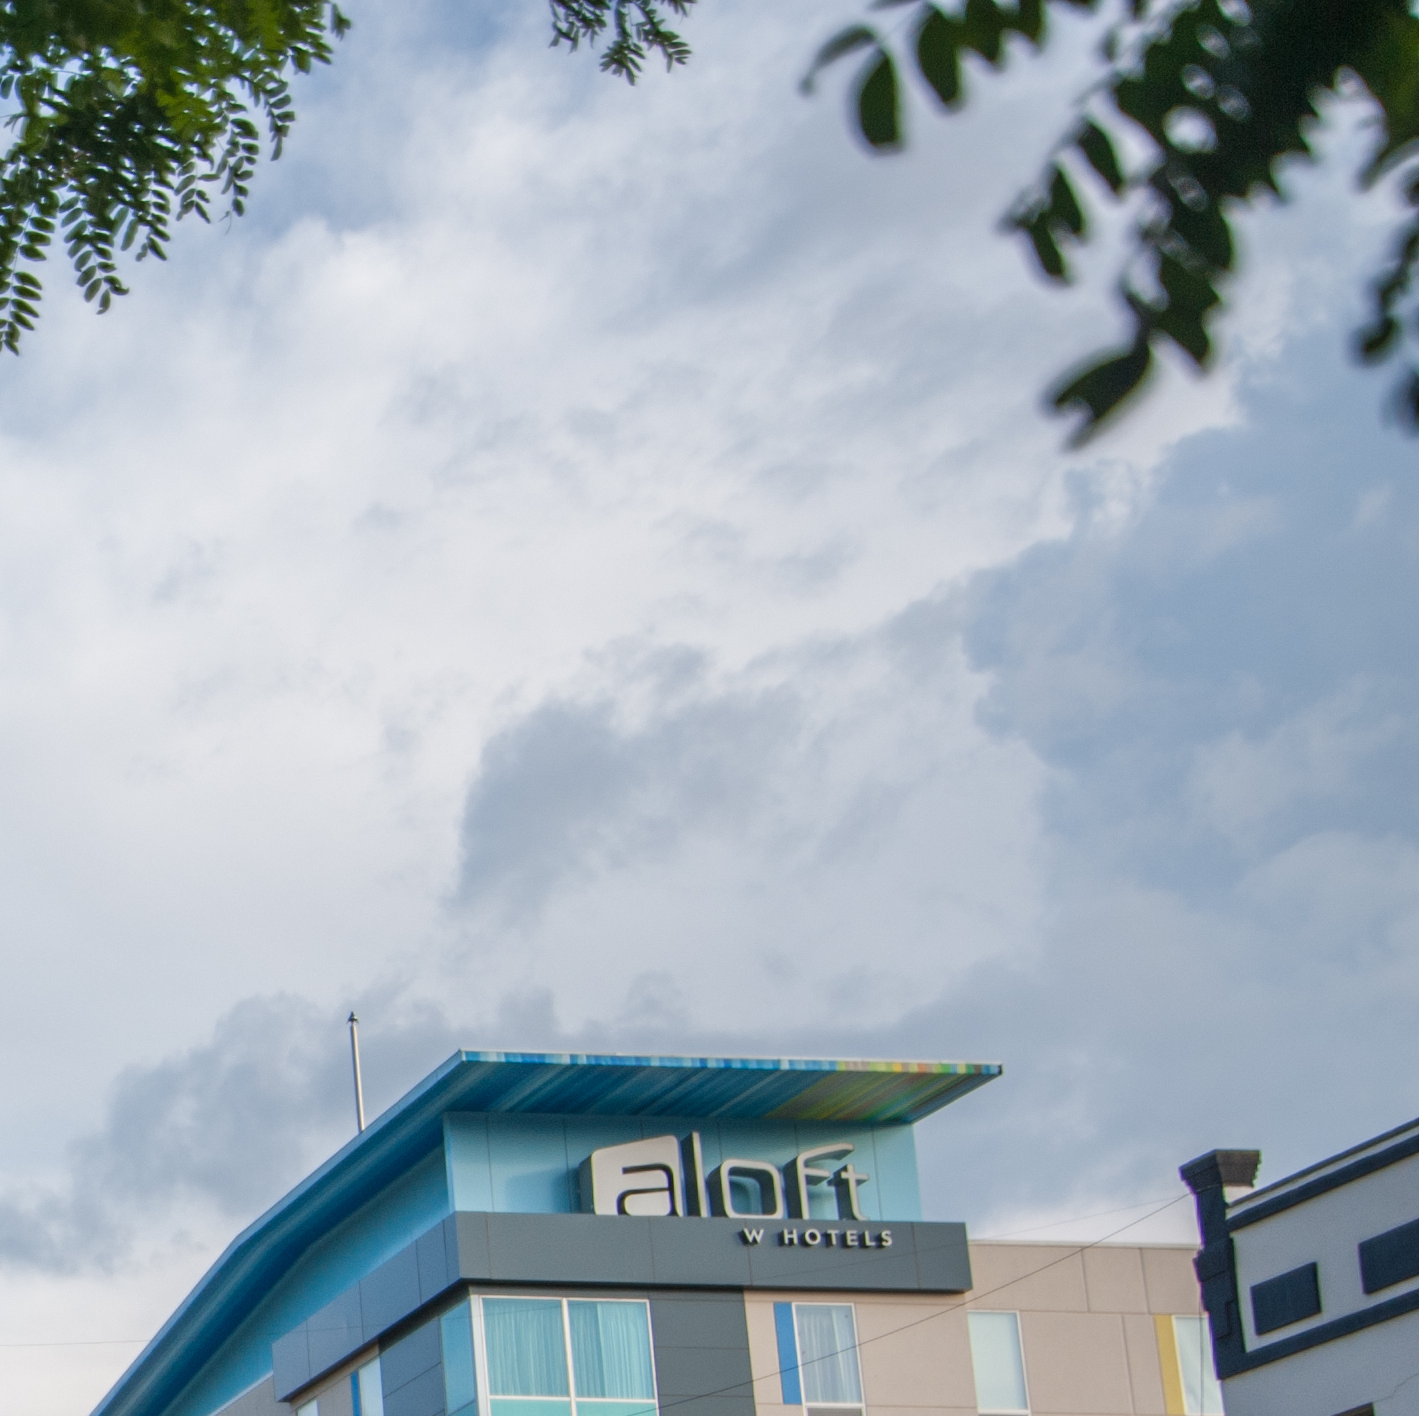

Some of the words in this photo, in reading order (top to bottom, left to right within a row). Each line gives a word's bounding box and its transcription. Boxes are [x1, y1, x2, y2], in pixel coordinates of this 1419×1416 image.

[581, 1131, 870, 1221] aloft
[743, 1227, 764, 1246] W
[782, 1228, 894, 1248] HOTELS
